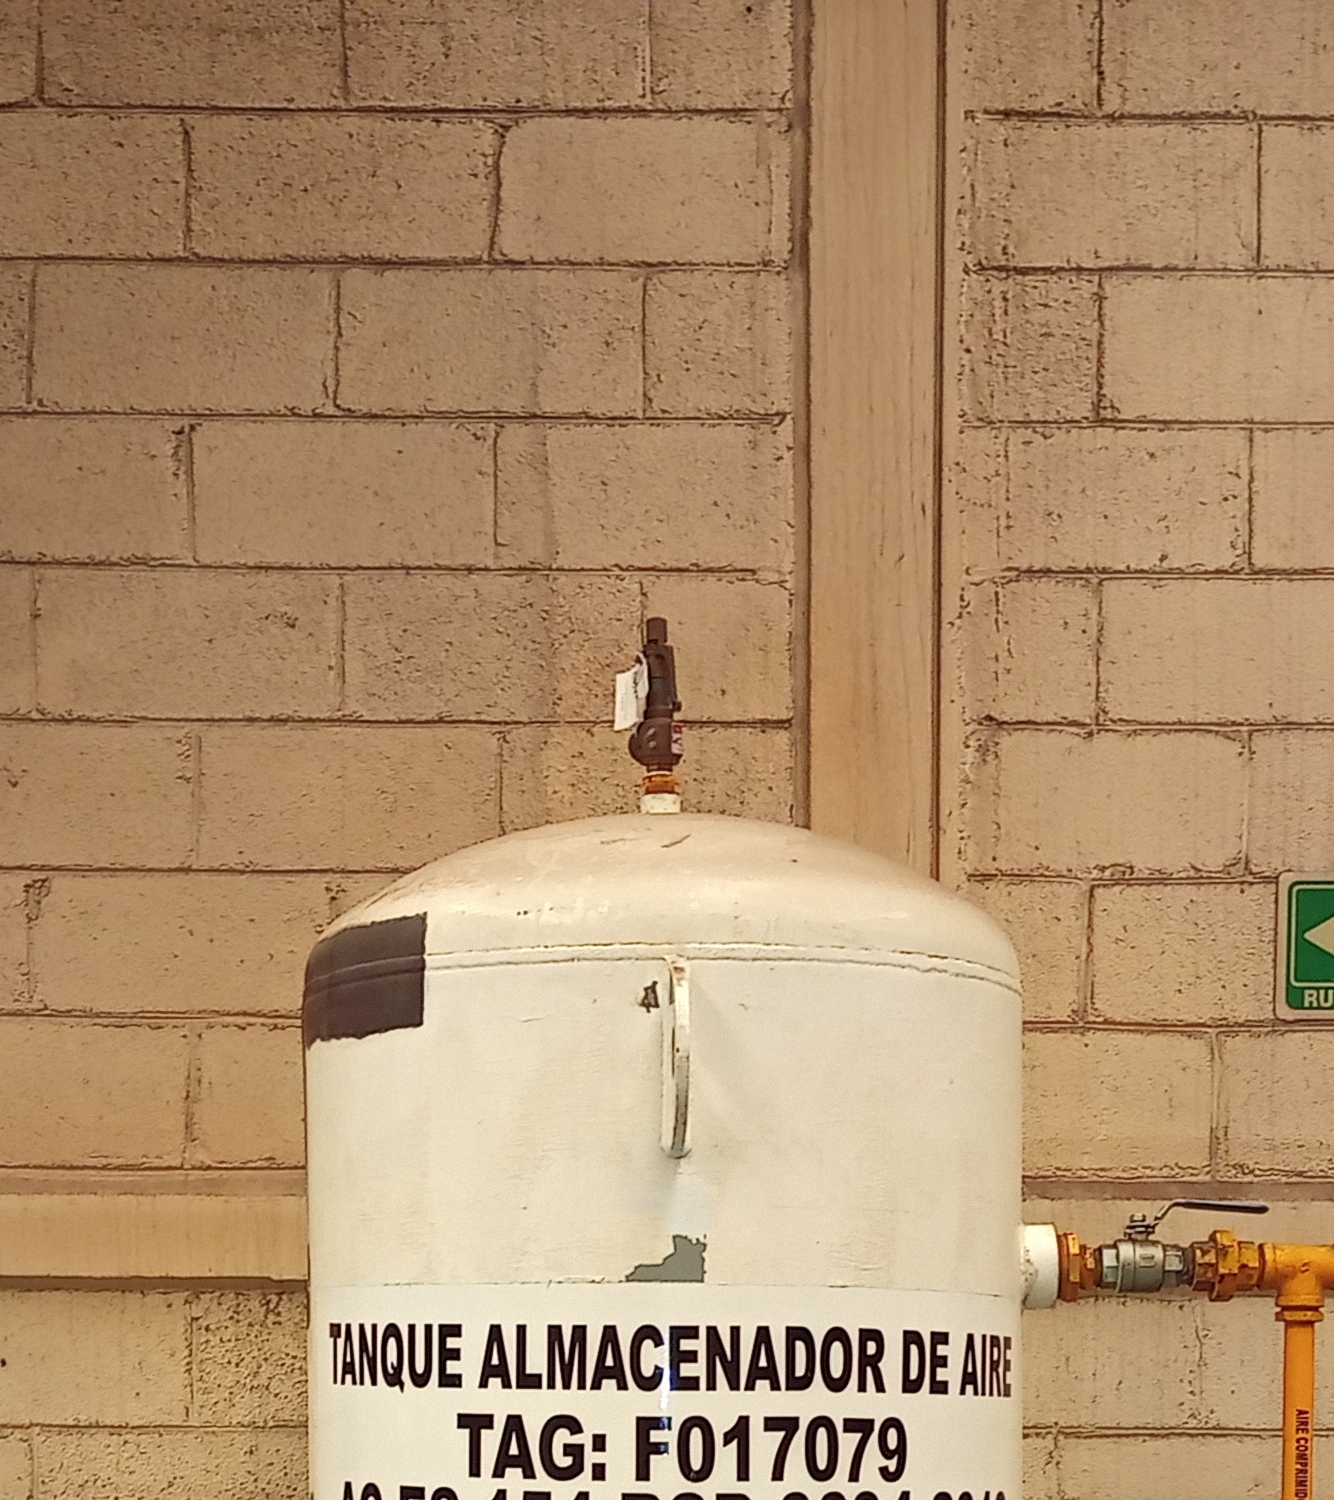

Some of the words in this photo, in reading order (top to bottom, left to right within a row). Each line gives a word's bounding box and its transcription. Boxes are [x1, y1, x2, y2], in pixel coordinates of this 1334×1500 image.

[329, 1322, 464, 1393] TANQUE
[478, 1323, 886, 1393] ALMACENADOR
[901, 1330, 950, 1395] DE
[959, 1331, 1013, 1398] AIRE
[457, 1413, 607, 1480] TAG:
[635, 1415, 908, 1482] F017079
[1295, 1408, 1310, 1434] AIRE
